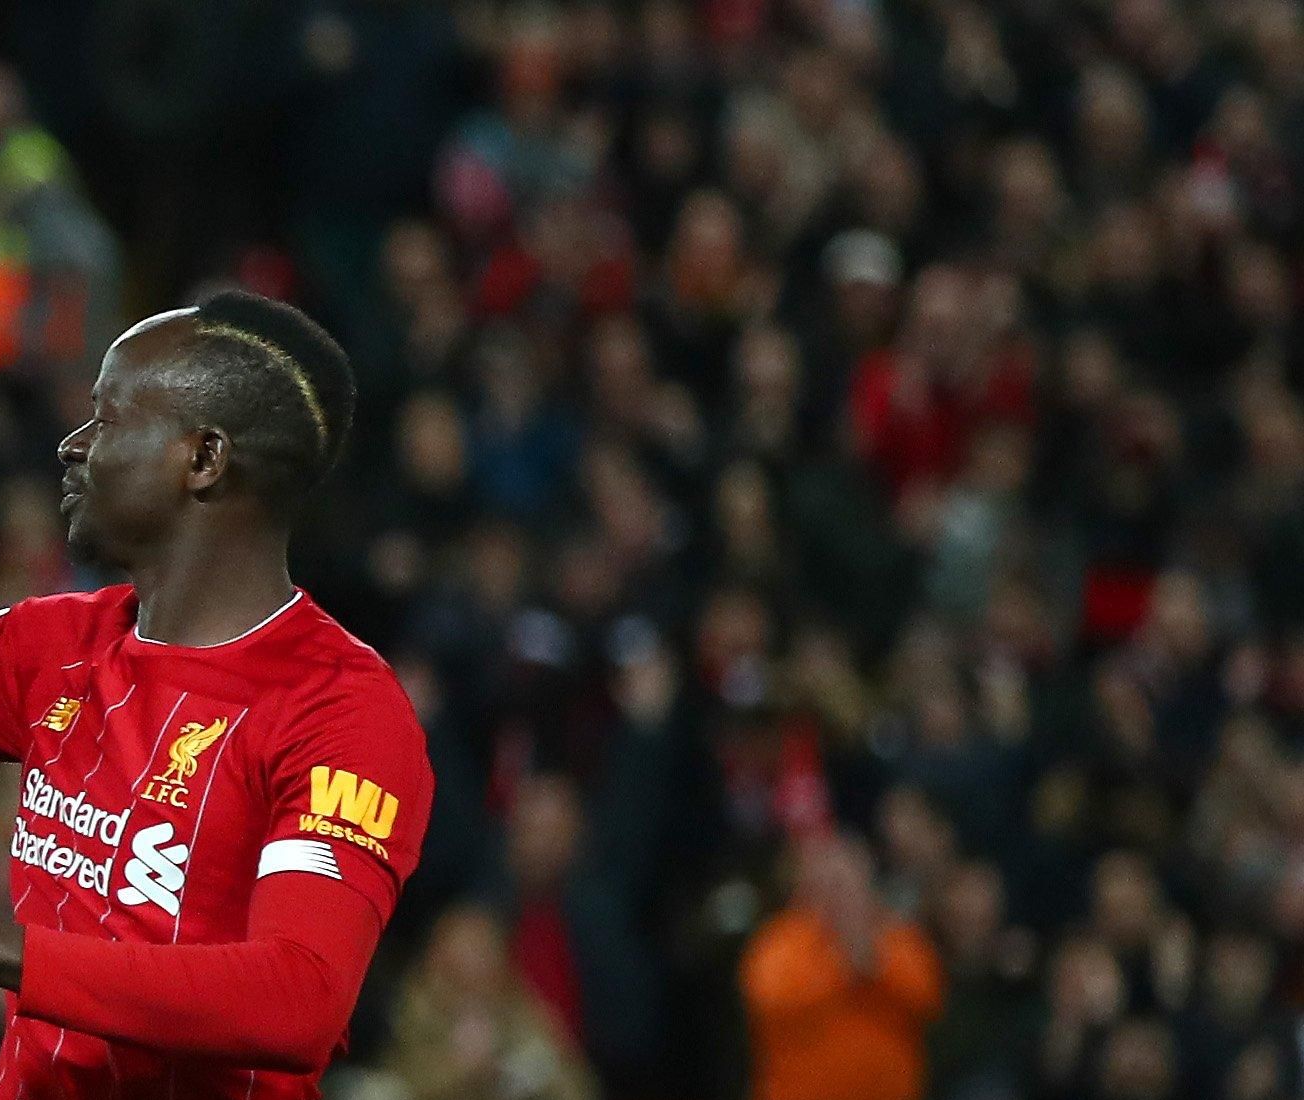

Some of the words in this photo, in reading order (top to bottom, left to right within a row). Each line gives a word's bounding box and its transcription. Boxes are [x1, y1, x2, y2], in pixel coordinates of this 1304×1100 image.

[22, 768, 131, 847] Standard
[298, 813, 389, 860] Western
[310, 765, 399, 839] WU
